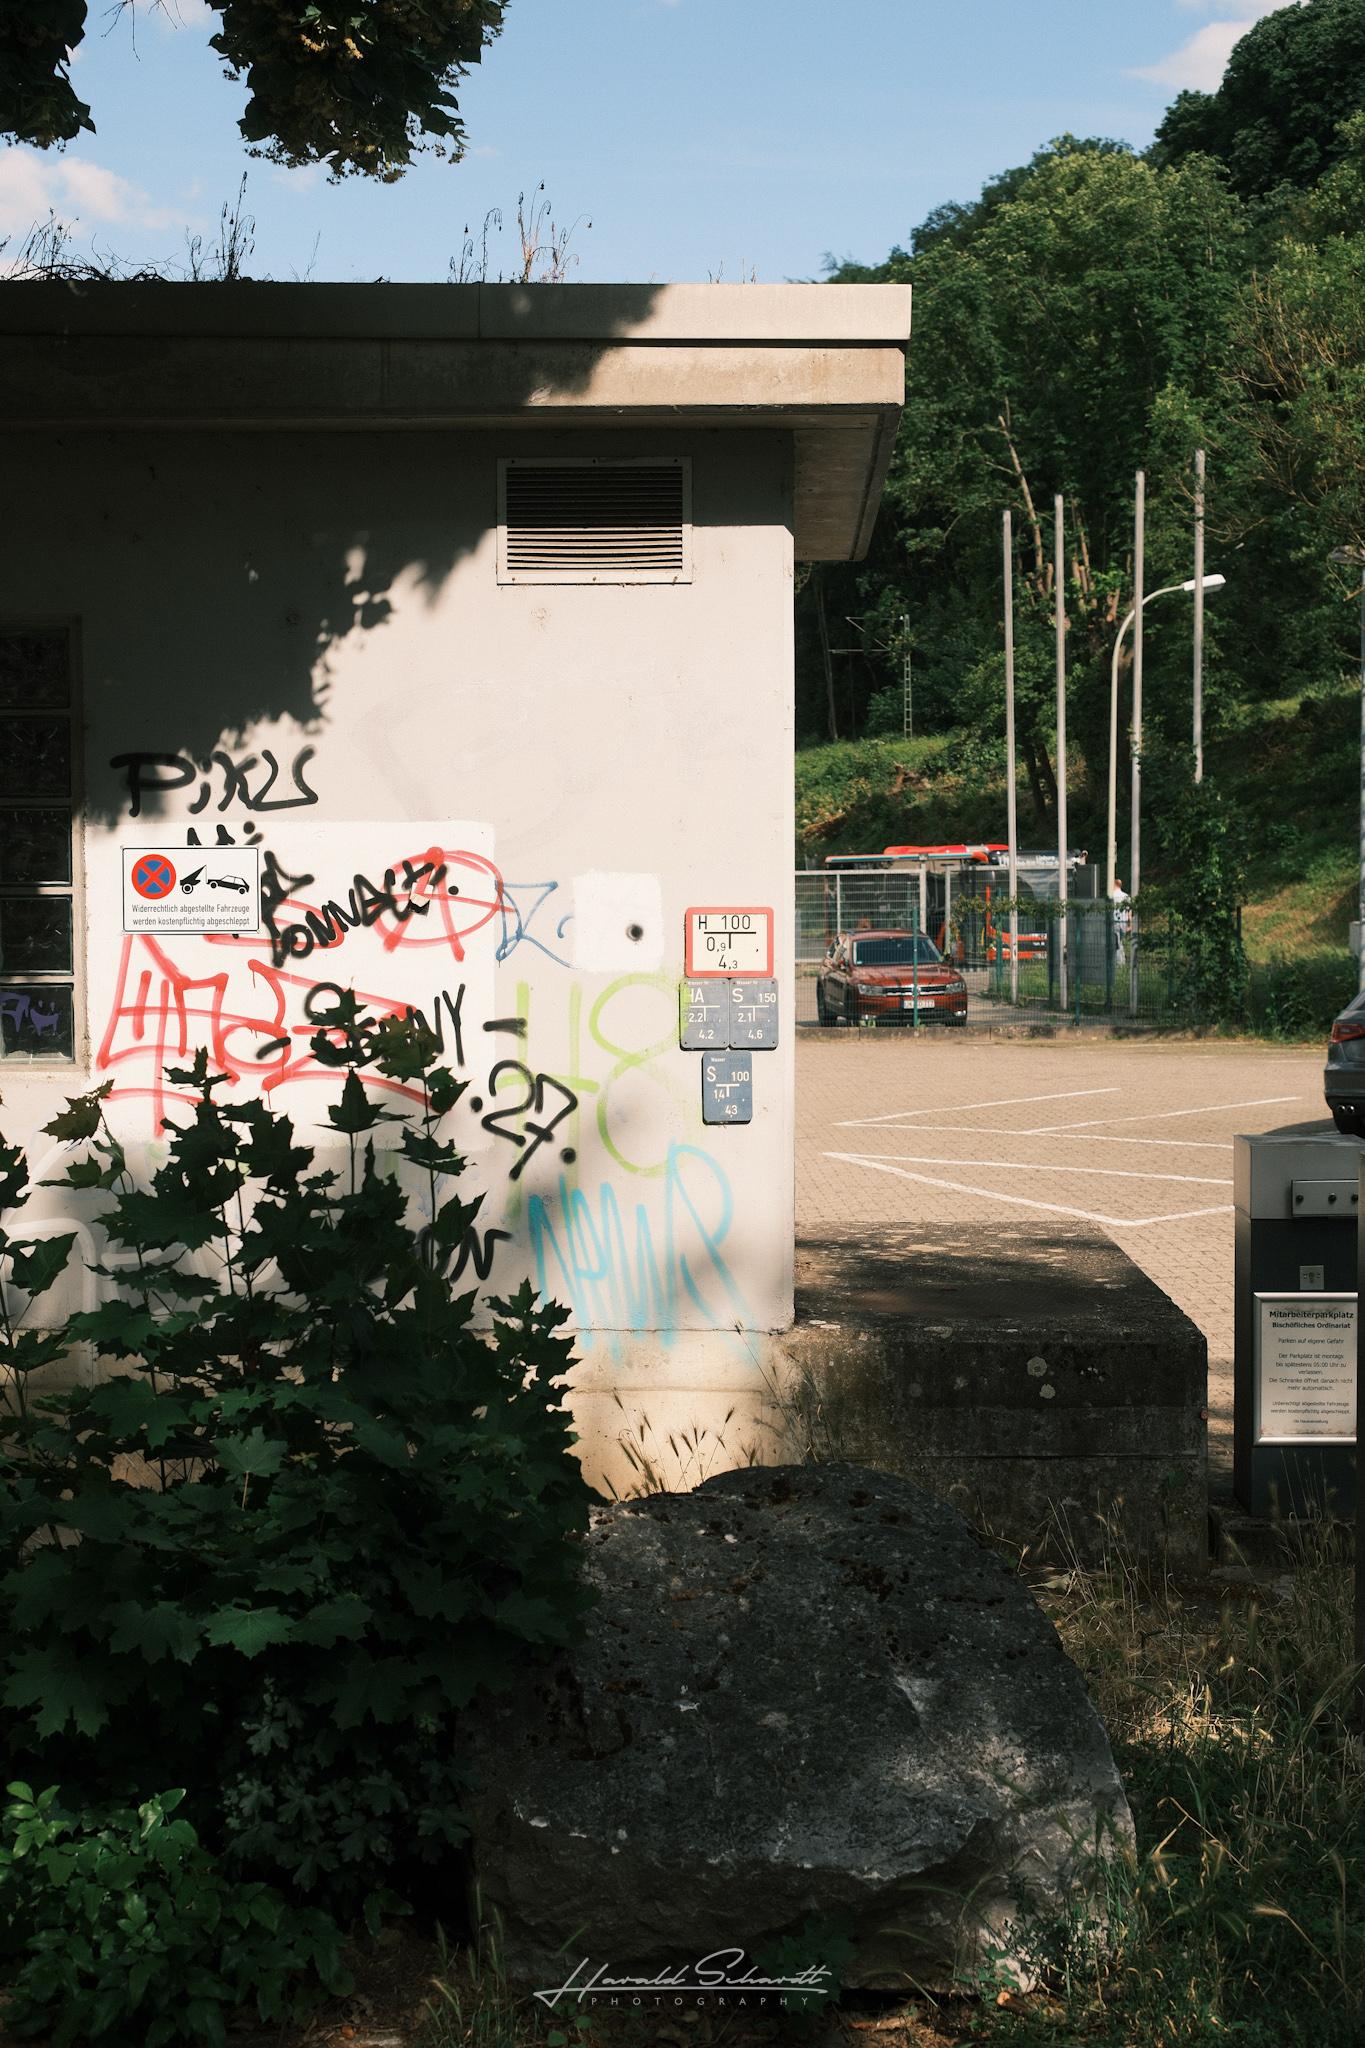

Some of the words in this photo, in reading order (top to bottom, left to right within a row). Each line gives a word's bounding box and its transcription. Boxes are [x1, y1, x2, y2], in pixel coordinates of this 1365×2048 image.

[132, 904, 178, 913] Widerrechtlich
[180, 904, 215, 914] abgestellte
[217, 904, 250, 914] Fahrzeuge
[132, 917, 157, 926] werden
[158, 917, 205, 927] kostenpflichtig
[206, 917, 250, 927] abgeschleppt
[698, 914, 708, 930] H
[721, 914, 751, 930] 100
[718, 954, 738, 970] 4,3
[732, 987, 744, 1003] S
[759, 993, 776, 1003] 150
[706, 1066, 716, 1082] S
[731, 1071, 750, 1082] 100
[1269, 1311, 1354, 1320] Mitarbeiterparkplatz
